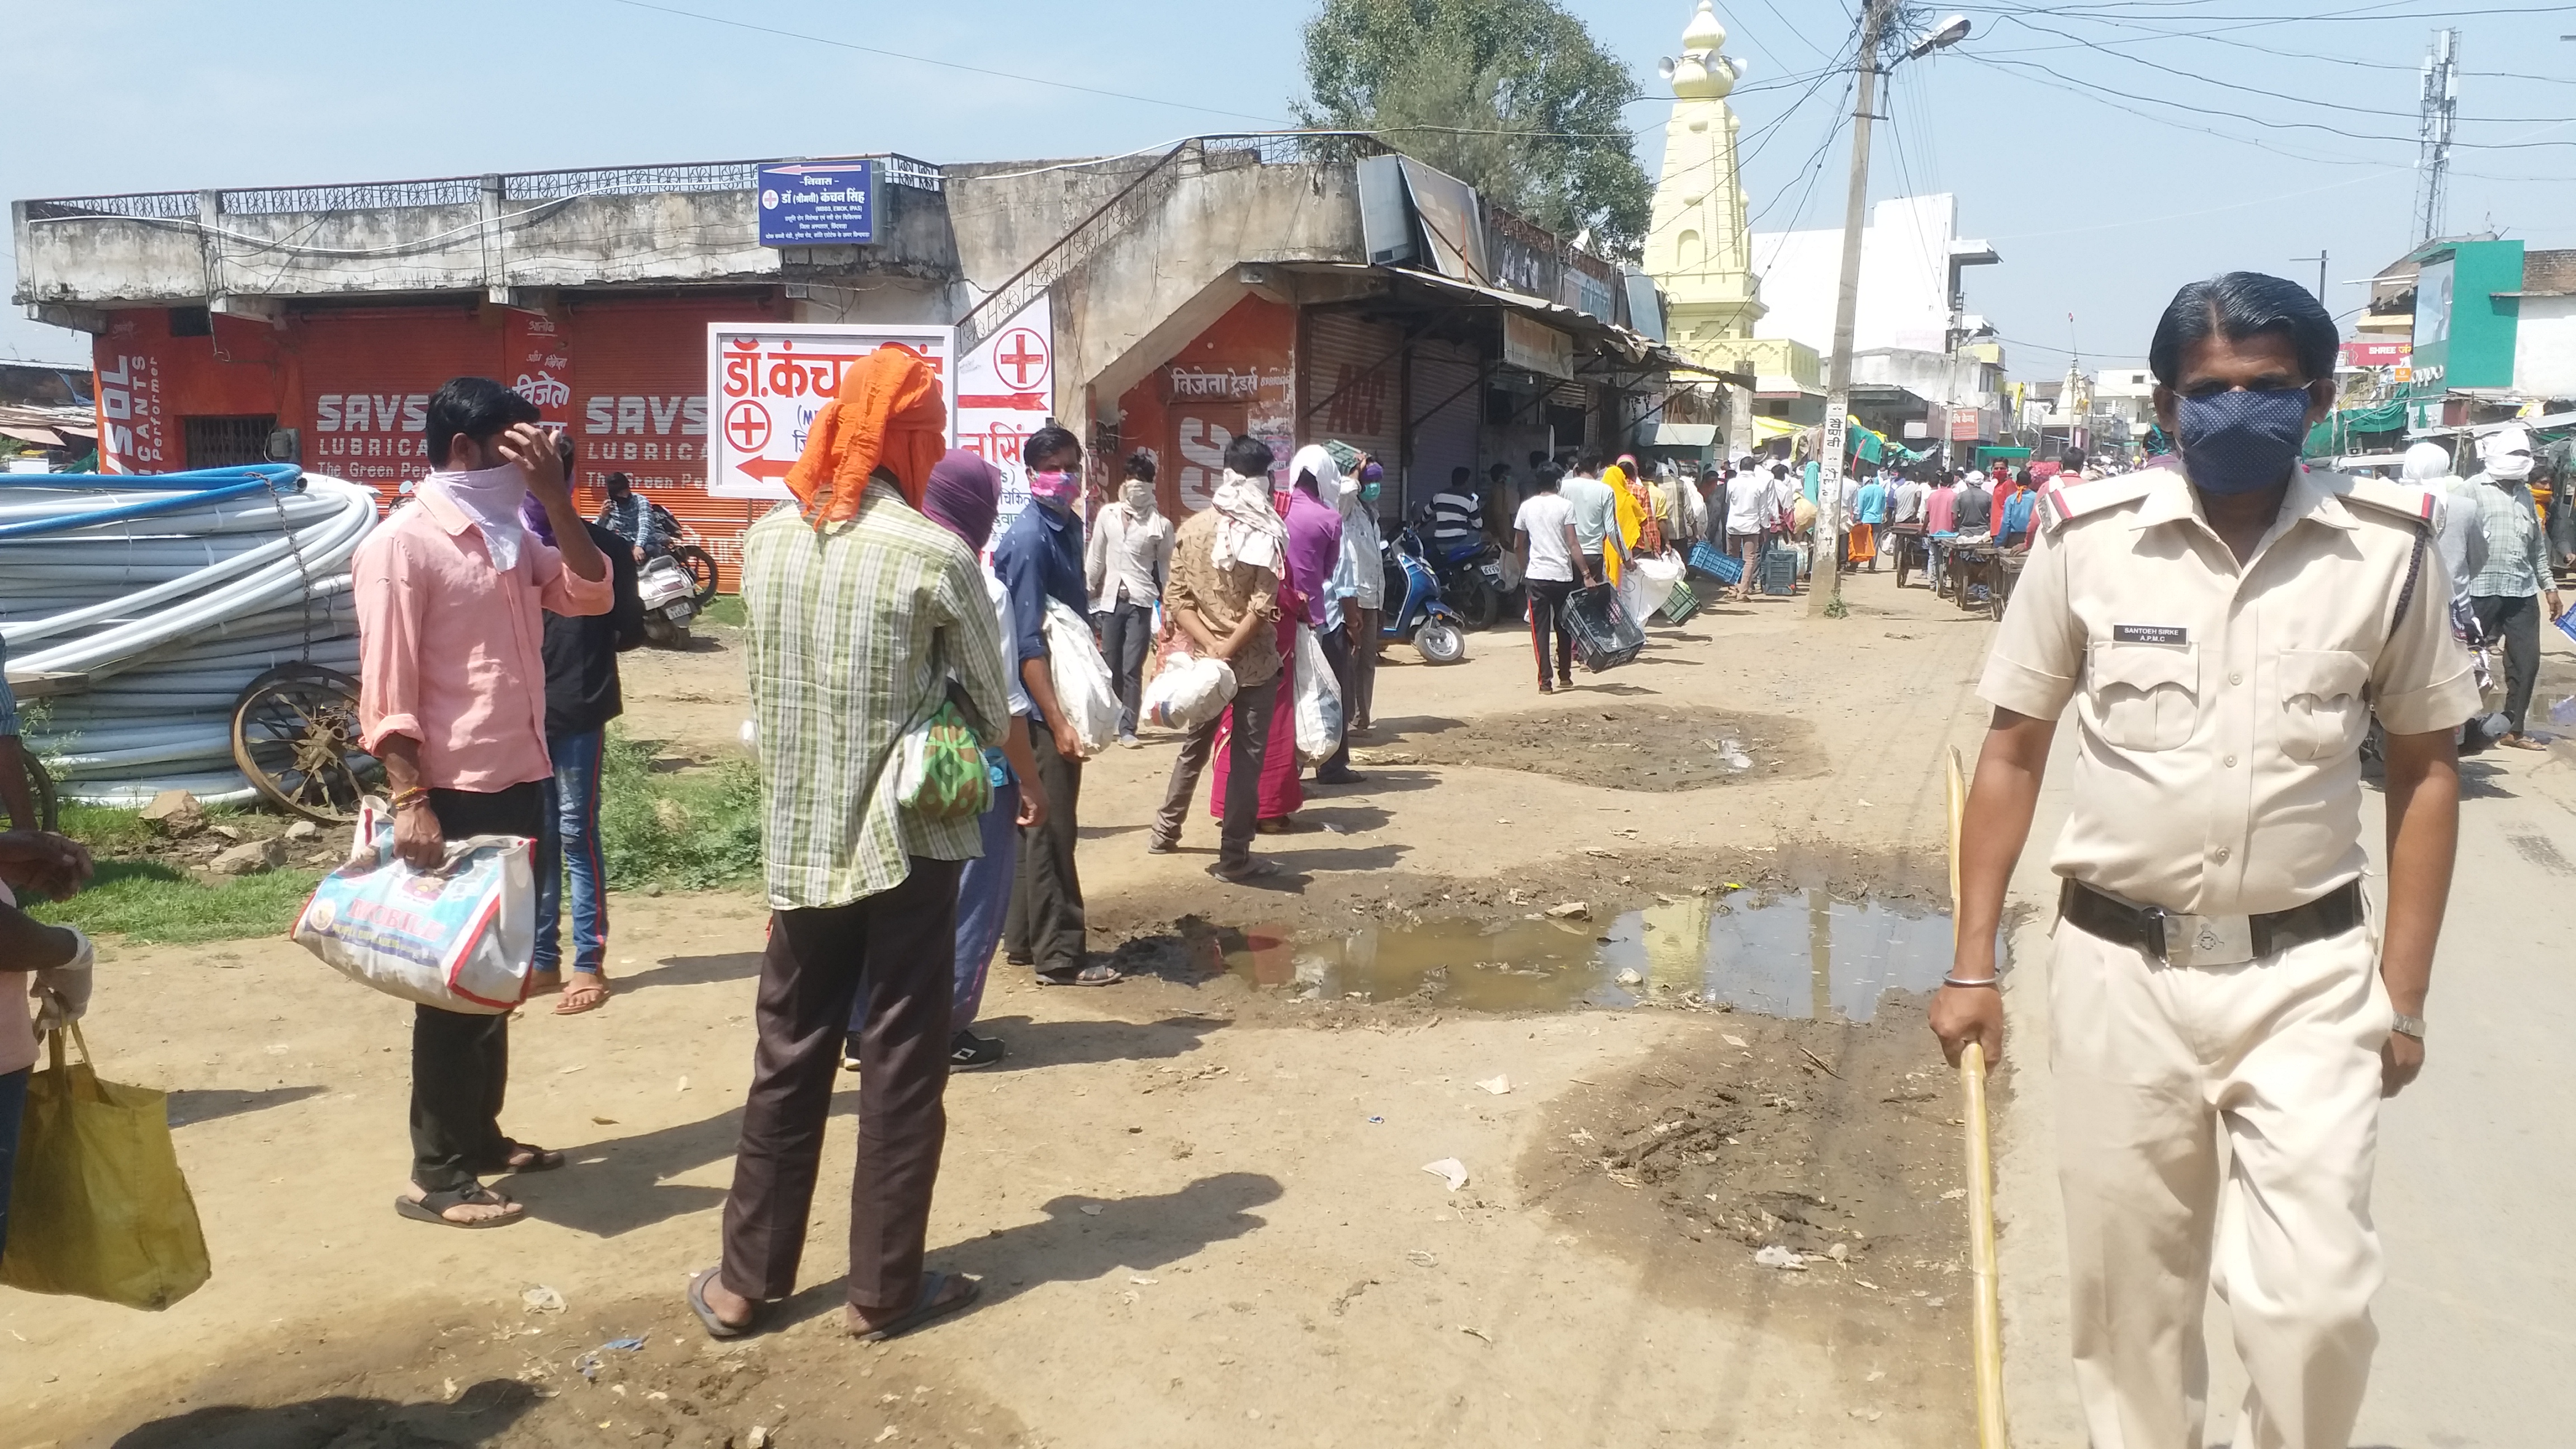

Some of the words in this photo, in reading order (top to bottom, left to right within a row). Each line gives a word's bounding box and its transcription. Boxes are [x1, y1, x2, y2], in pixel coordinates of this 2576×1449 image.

[820, 188, 845, 202] कंचन
[846, 187, 865, 203] सिंह
[2411, 364, 2444, 388] oppo
[150, 357, 163, 461] Performer
[1326, 363, 1386, 436] ACC
[349, 462, 394, 477] Green
[347, 897, 446, 941] MOBILE
